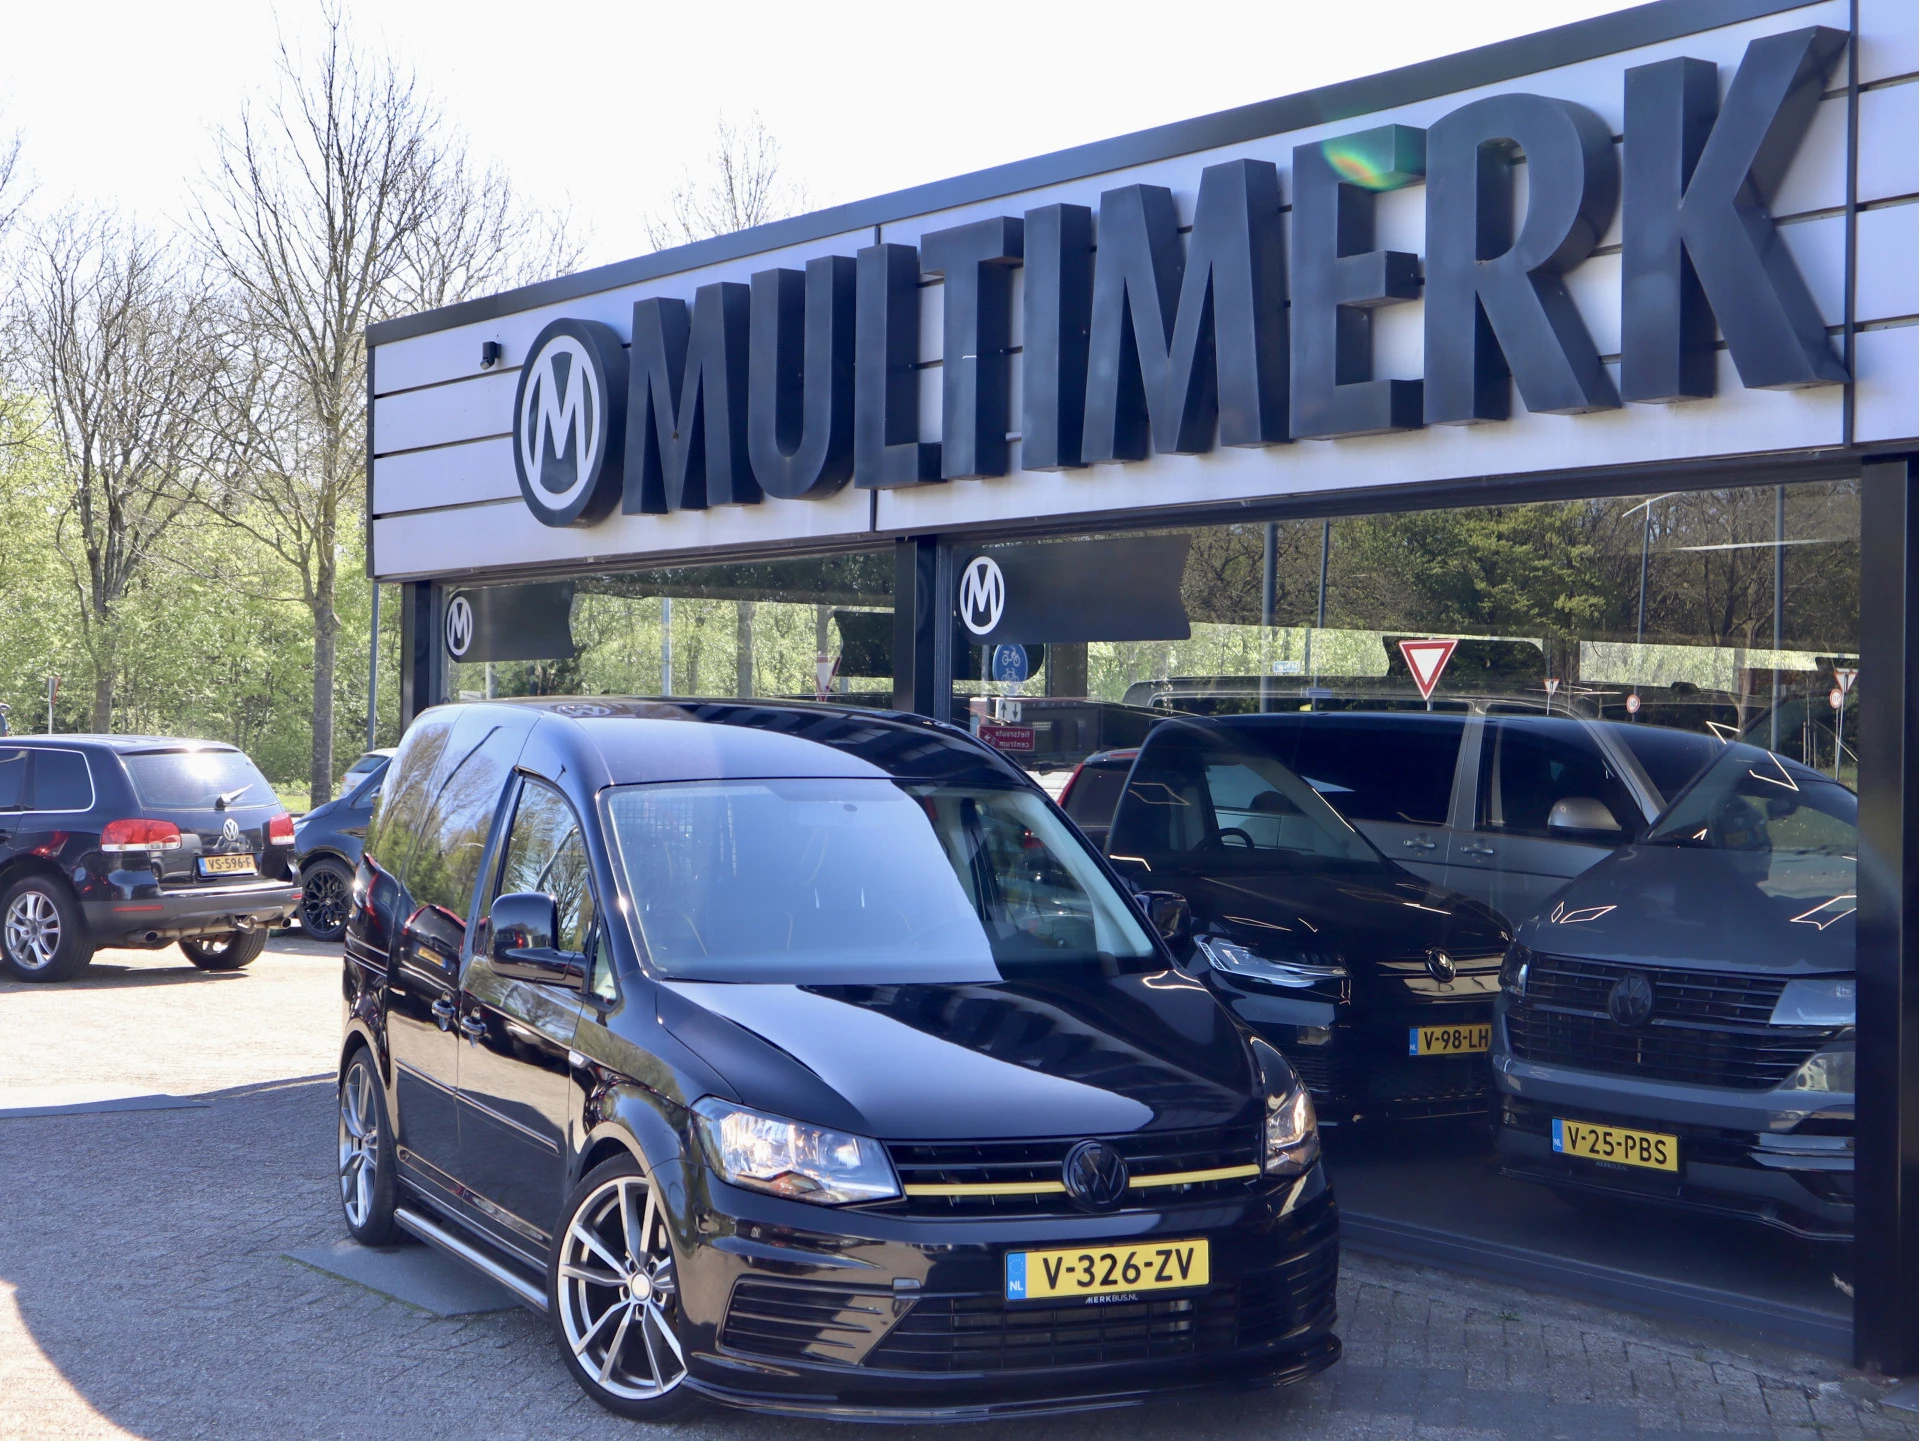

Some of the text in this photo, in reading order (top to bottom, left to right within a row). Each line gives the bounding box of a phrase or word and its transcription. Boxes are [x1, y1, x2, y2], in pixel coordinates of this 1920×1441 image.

[622, 25, 1851, 515] MULTIMERK
[208, 857, 251, 870] VS-596-F
[1424, 1028, 1489, 1051] V-98-LH
[1567, 1125, 1667, 1165] V-25-PBS
[1009, 1247, 1194, 1292] NL V-326-ZV
